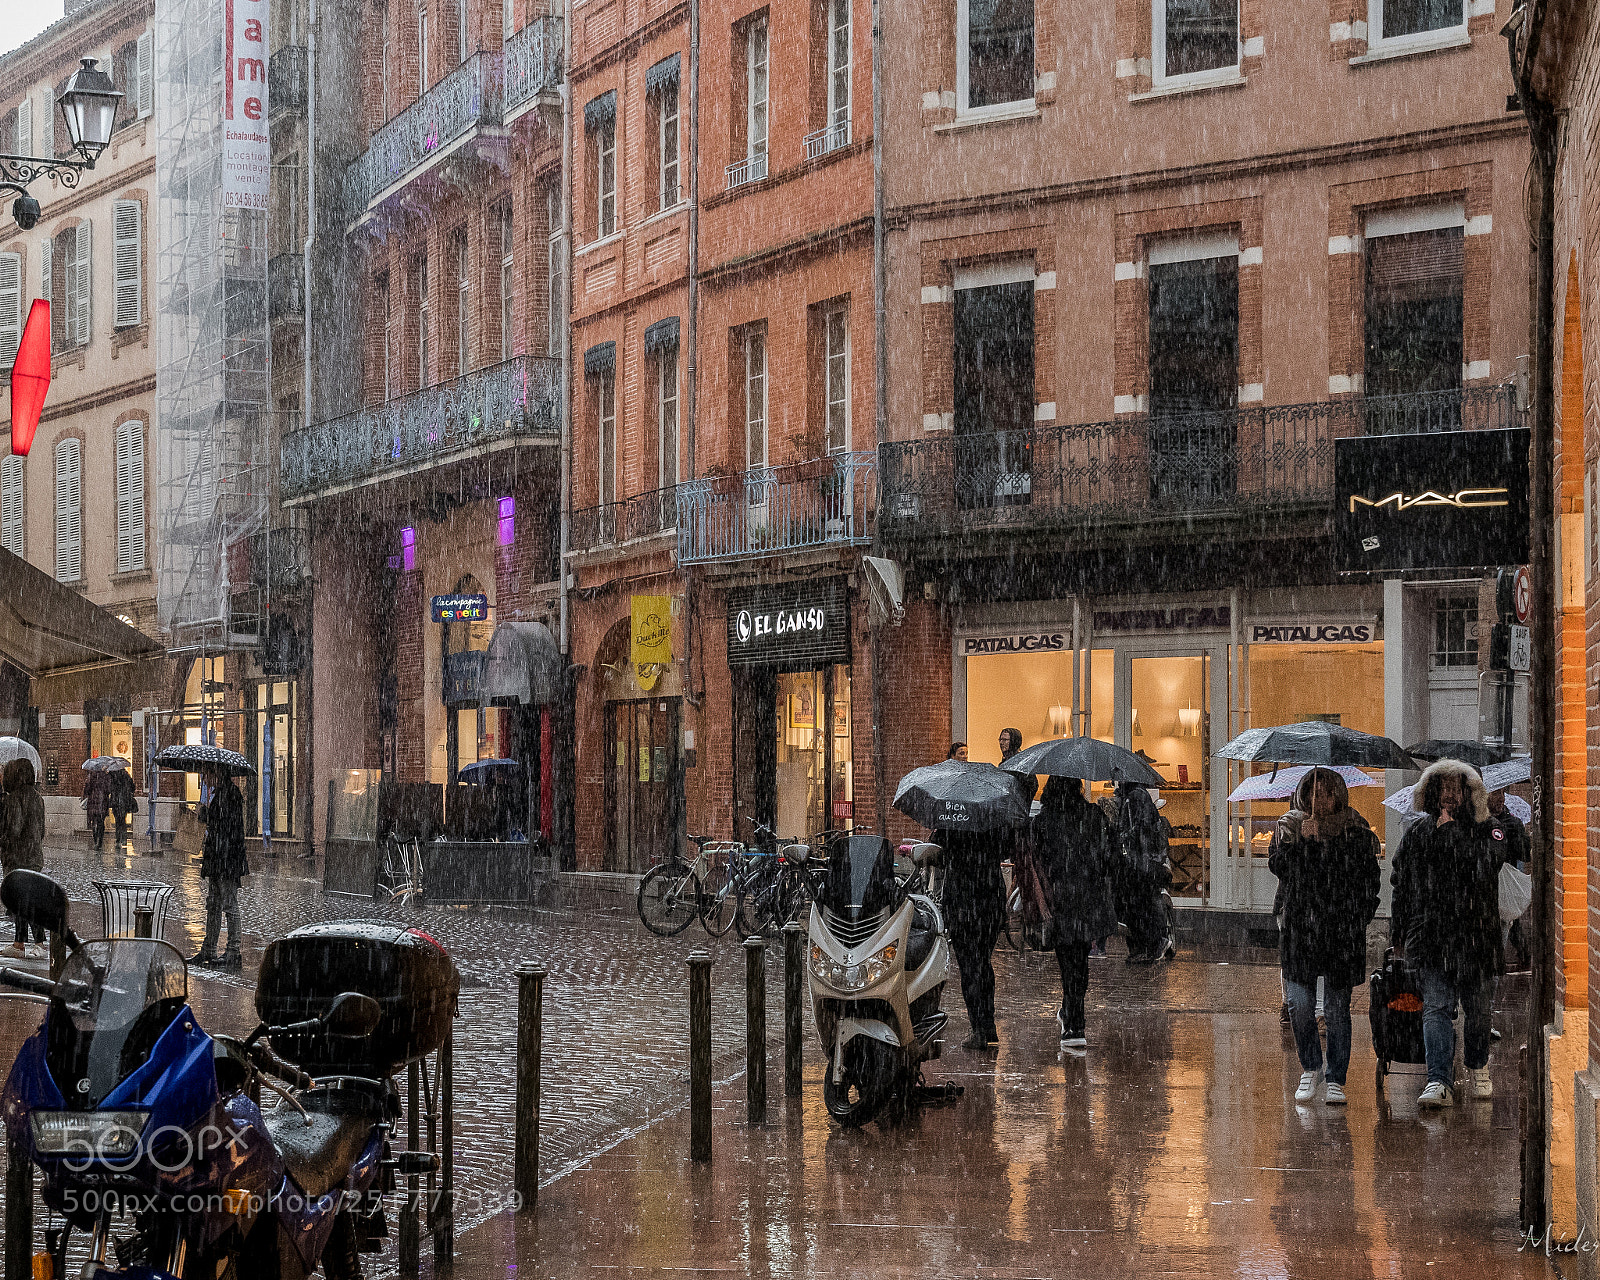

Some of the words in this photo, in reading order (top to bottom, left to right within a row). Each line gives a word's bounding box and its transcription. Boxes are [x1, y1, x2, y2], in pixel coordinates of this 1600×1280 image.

[226, 127, 268, 144] Échafaudages
[227, 150, 268, 161] Location
[226, 162, 269, 175] montage
[235, 174, 261, 184] vente
[754, 615, 773, 637] EL
[776, 608, 824, 634] GANSO
[1253, 625, 1370, 642] PATAUGAS
[1516, 628, 1527, 639] SAUF
[964, 634, 1064, 653] PATAUGAS
[945, 801, 966, 811] Bien
[952, 813, 970, 822] sec
